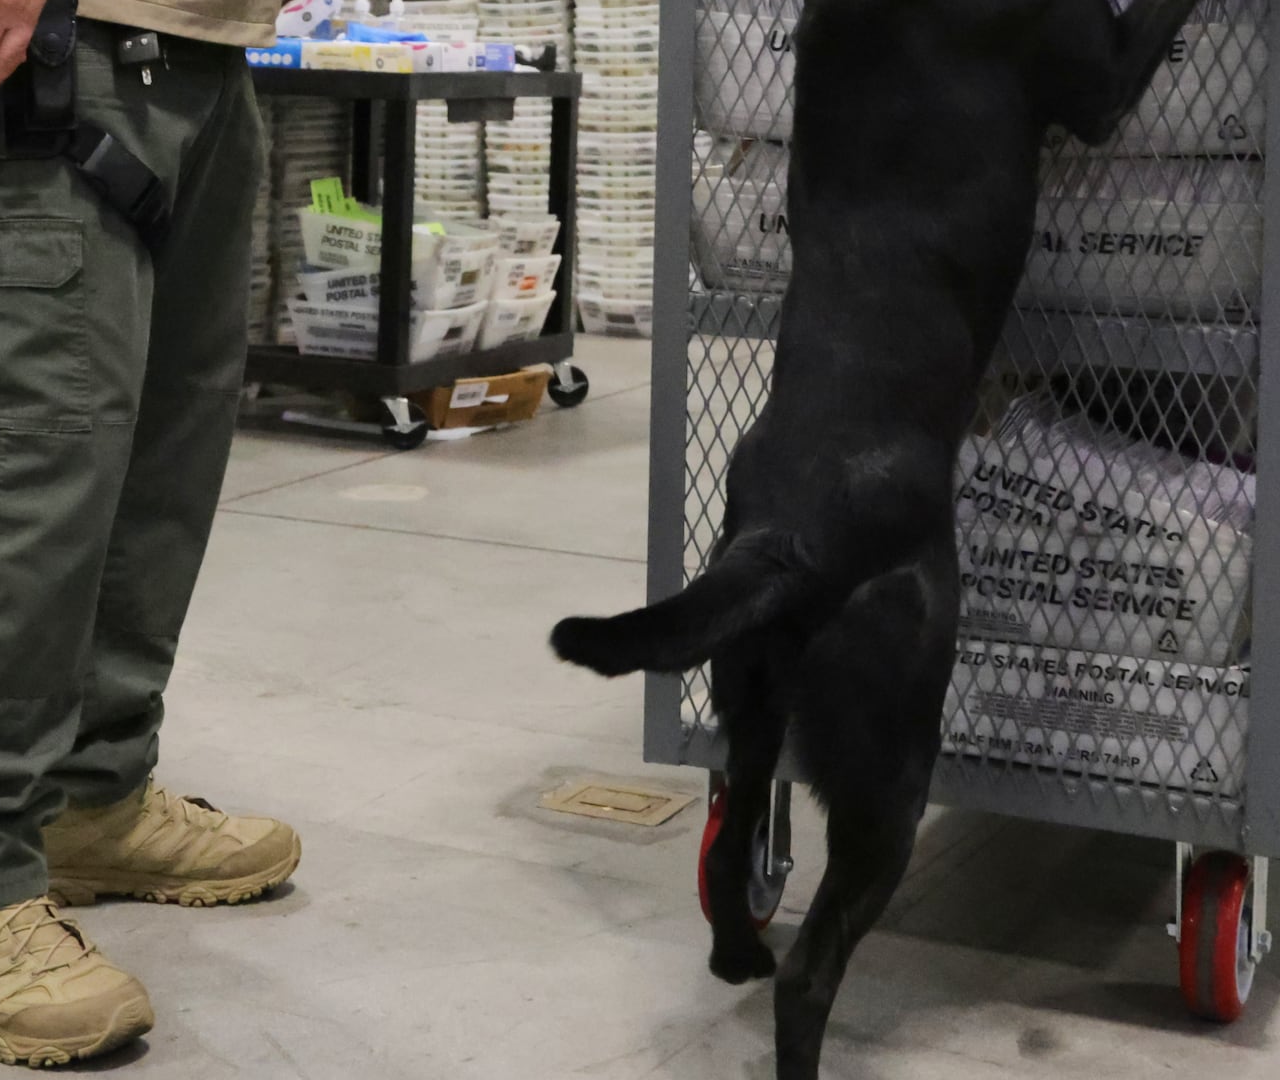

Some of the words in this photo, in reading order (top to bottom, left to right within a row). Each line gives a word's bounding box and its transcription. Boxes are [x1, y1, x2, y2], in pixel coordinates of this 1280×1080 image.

[326, 224, 363, 240] UNITED
[321, 236, 360, 252] POSTAL
[1079, 232, 1204, 257] SERVICE
[327, 275, 367, 289] UNITED
[326, 288, 368, 302] POSTAL
[975, 461, 1074, 511] UNITED
[956, 484, 1055, 527] POSTA
[970, 545, 1070, 576] UNITED
[1079, 558, 1184, 589] STATES
[961, 573, 1064, 605] POSTAL
[1072, 587, 1196, 621] SERVICE
[993, 654, 1069, 677] STATES
[1075, 663, 1156, 686] POSTAL
[1047, 686, 1115, 704] WANING
[1016, 740, 1054, 757] RAY
